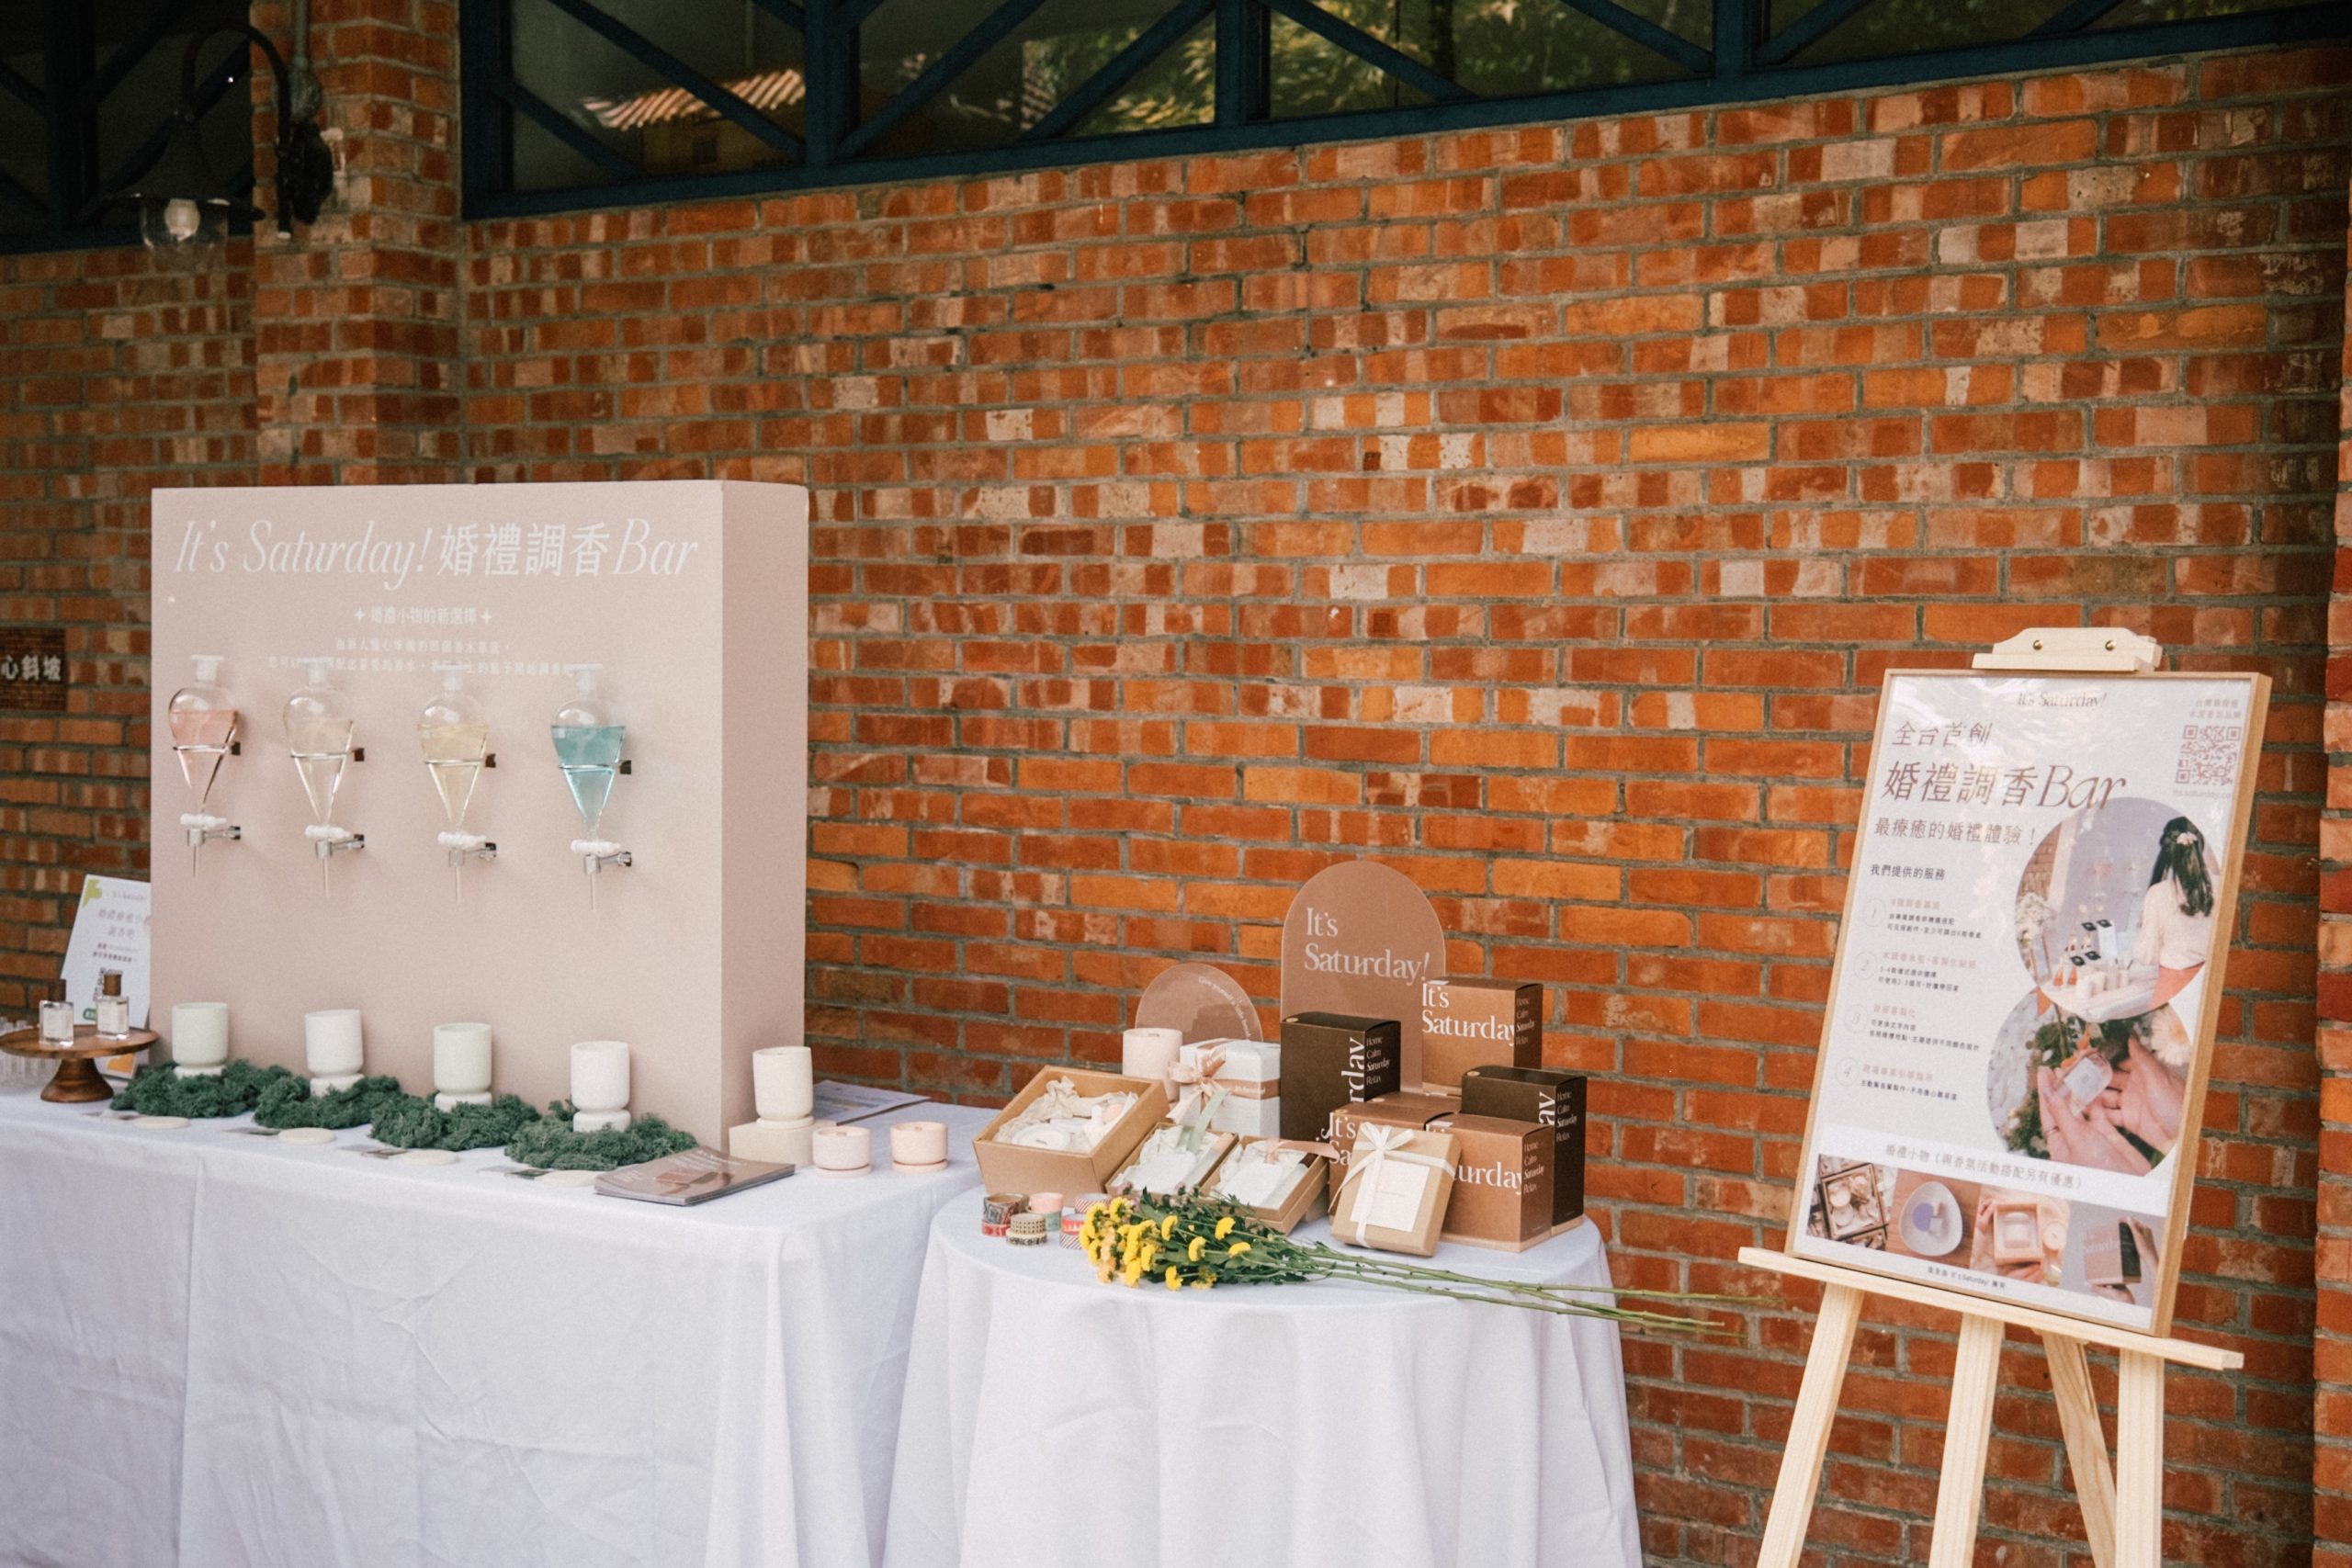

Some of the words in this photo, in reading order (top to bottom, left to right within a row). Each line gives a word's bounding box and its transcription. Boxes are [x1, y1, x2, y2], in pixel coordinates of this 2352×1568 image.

[175, 520, 230, 572] It's
[243, 519, 432, 590] Saturday!
[1891, 720, 1992, 747] 全台首創
[1871, 863, 1946, 881] 我們提供的服務
[1306, 907, 1339, 937] It's
[1305, 942, 1430, 986] Saturday!
[1421, 983, 1450, 1009] It's
[1366, 1036, 1383, 1047] Home
[1341, 1036, 1364, 1102] rday
[1329, 1111, 1357, 1140] It's
